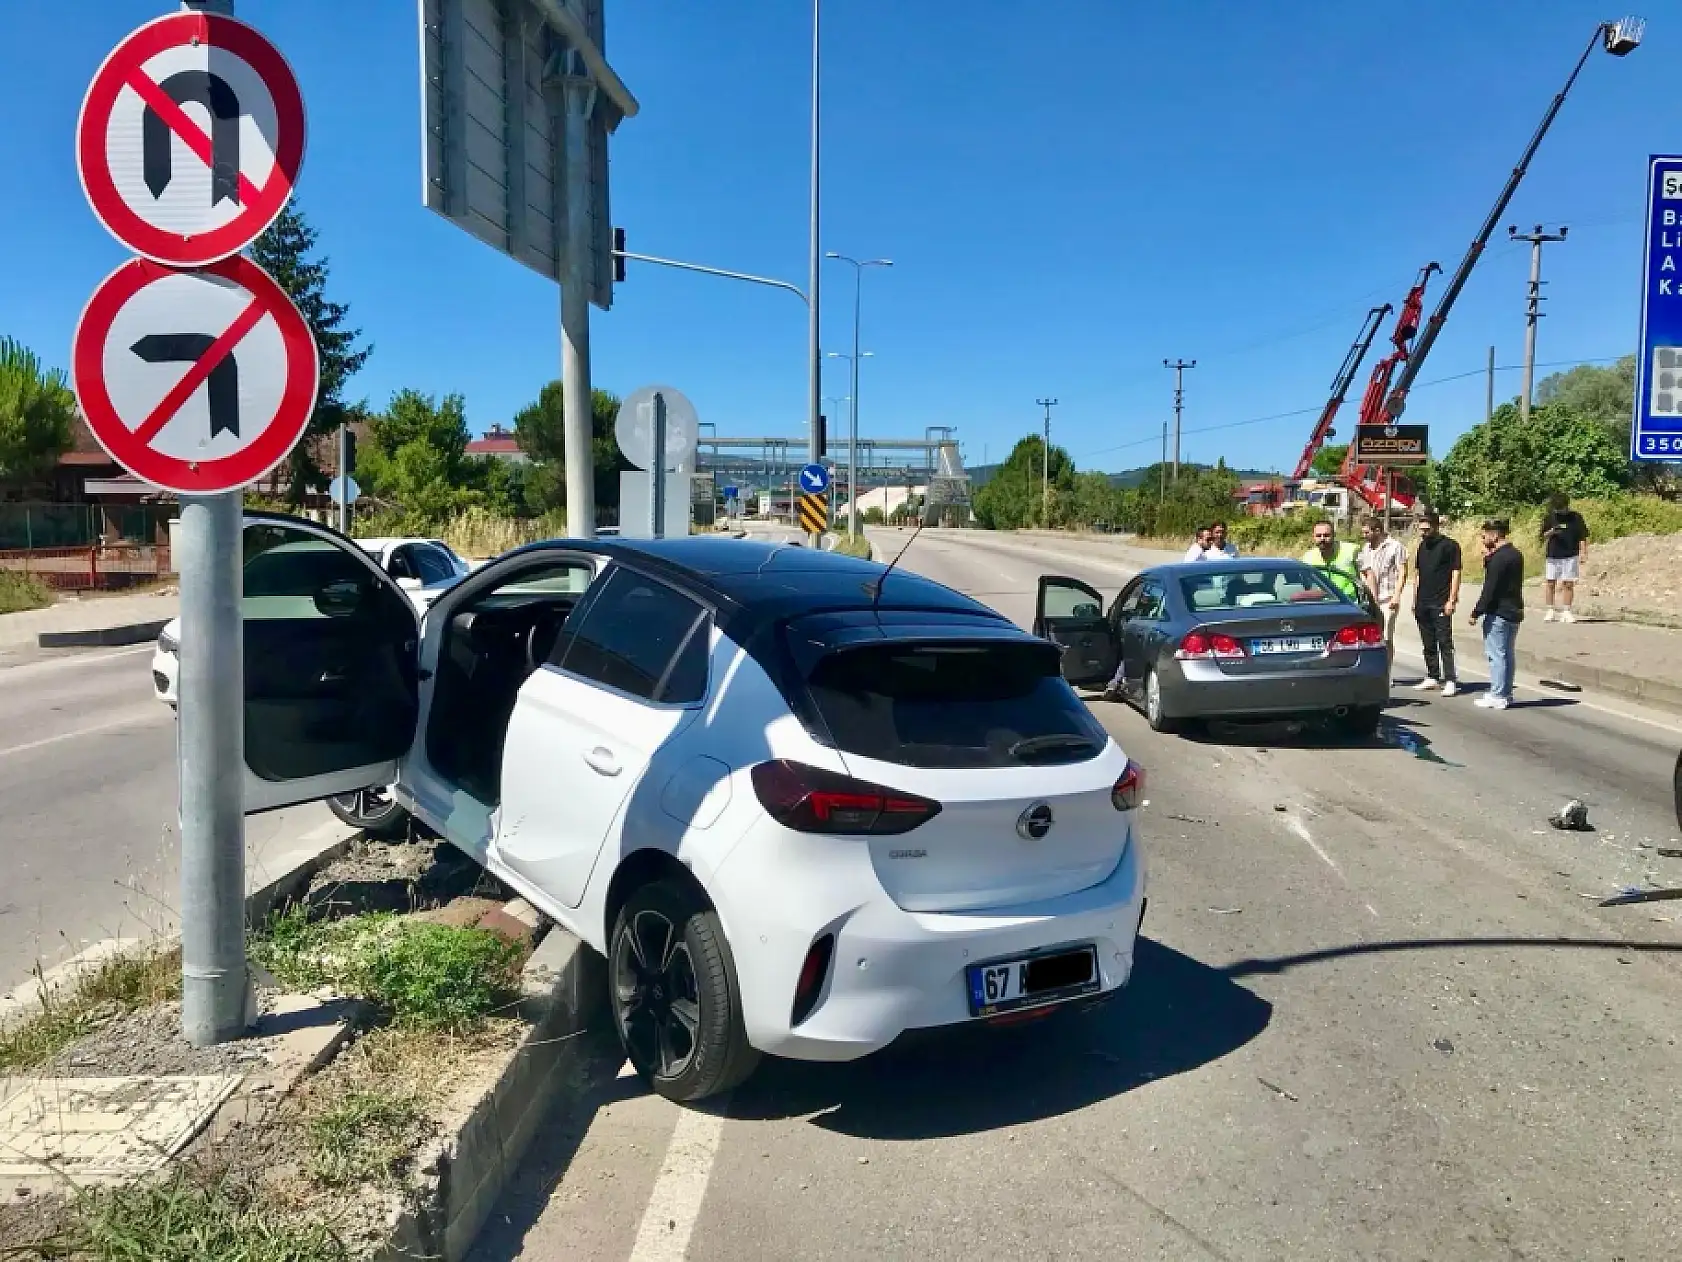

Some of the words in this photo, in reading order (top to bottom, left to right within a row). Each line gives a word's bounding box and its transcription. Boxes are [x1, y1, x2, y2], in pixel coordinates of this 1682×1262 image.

[1666, 177, 1682, 196] Ş
[1664, 209, 1682, 225] B
[985, 967, 1009, 1000] 67
